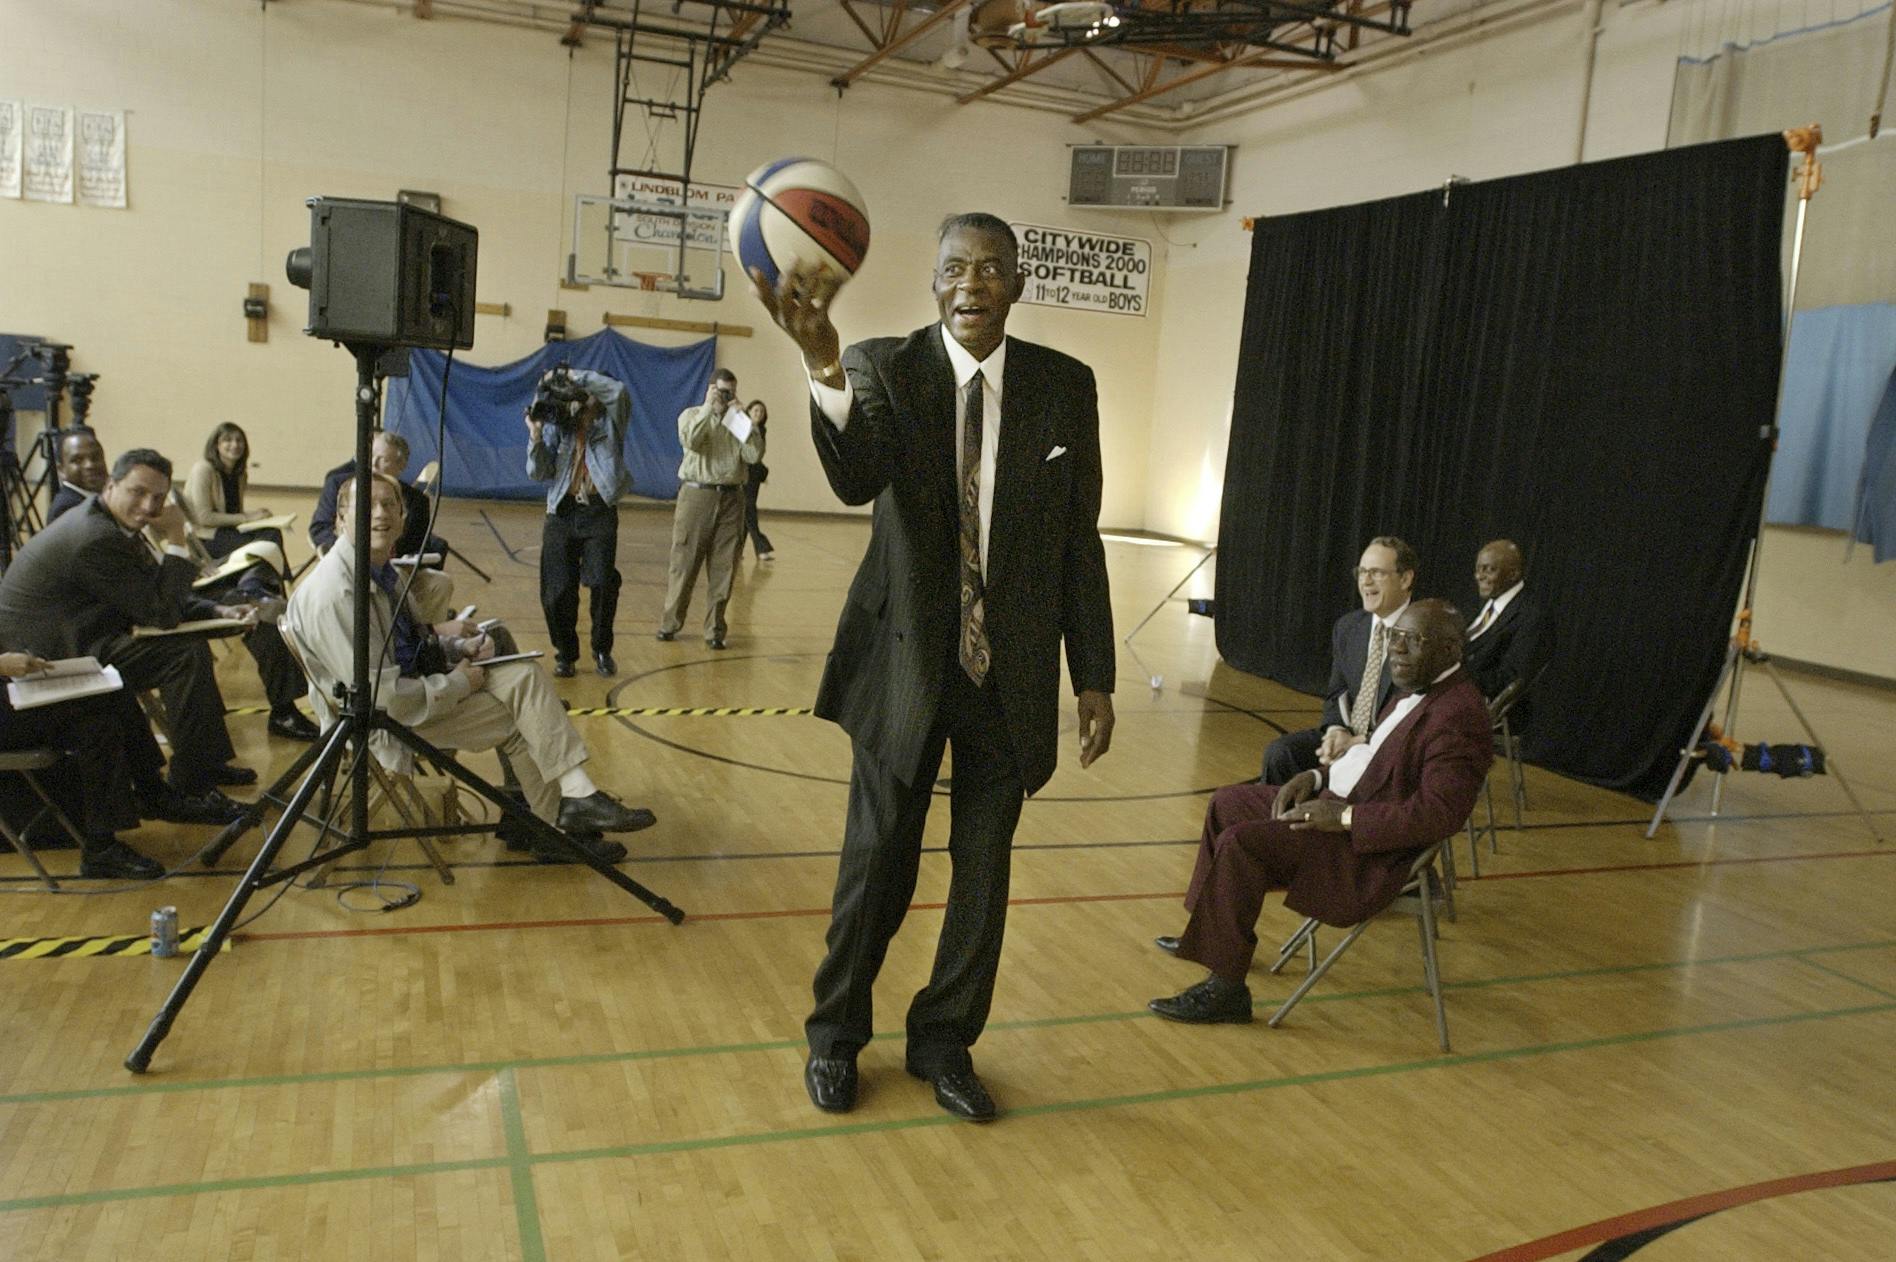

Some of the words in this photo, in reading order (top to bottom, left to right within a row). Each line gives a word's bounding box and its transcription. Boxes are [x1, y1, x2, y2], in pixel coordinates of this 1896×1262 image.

[631, 182, 709, 200] LINDBLOM
[716, 192, 735, 202] PA
[1024, 229, 1136, 256] CITYWIDE
[1018, 244, 1101, 269] HAMPIONS
[1105, 255, 1146, 274] 2000
[1020, 262, 1136, 290] SOFTBALL
[1071, 291, 1091, 301] YEAR
[1093, 294, 1108, 304] OLD
[1108, 292, 1142, 312] BOYS
